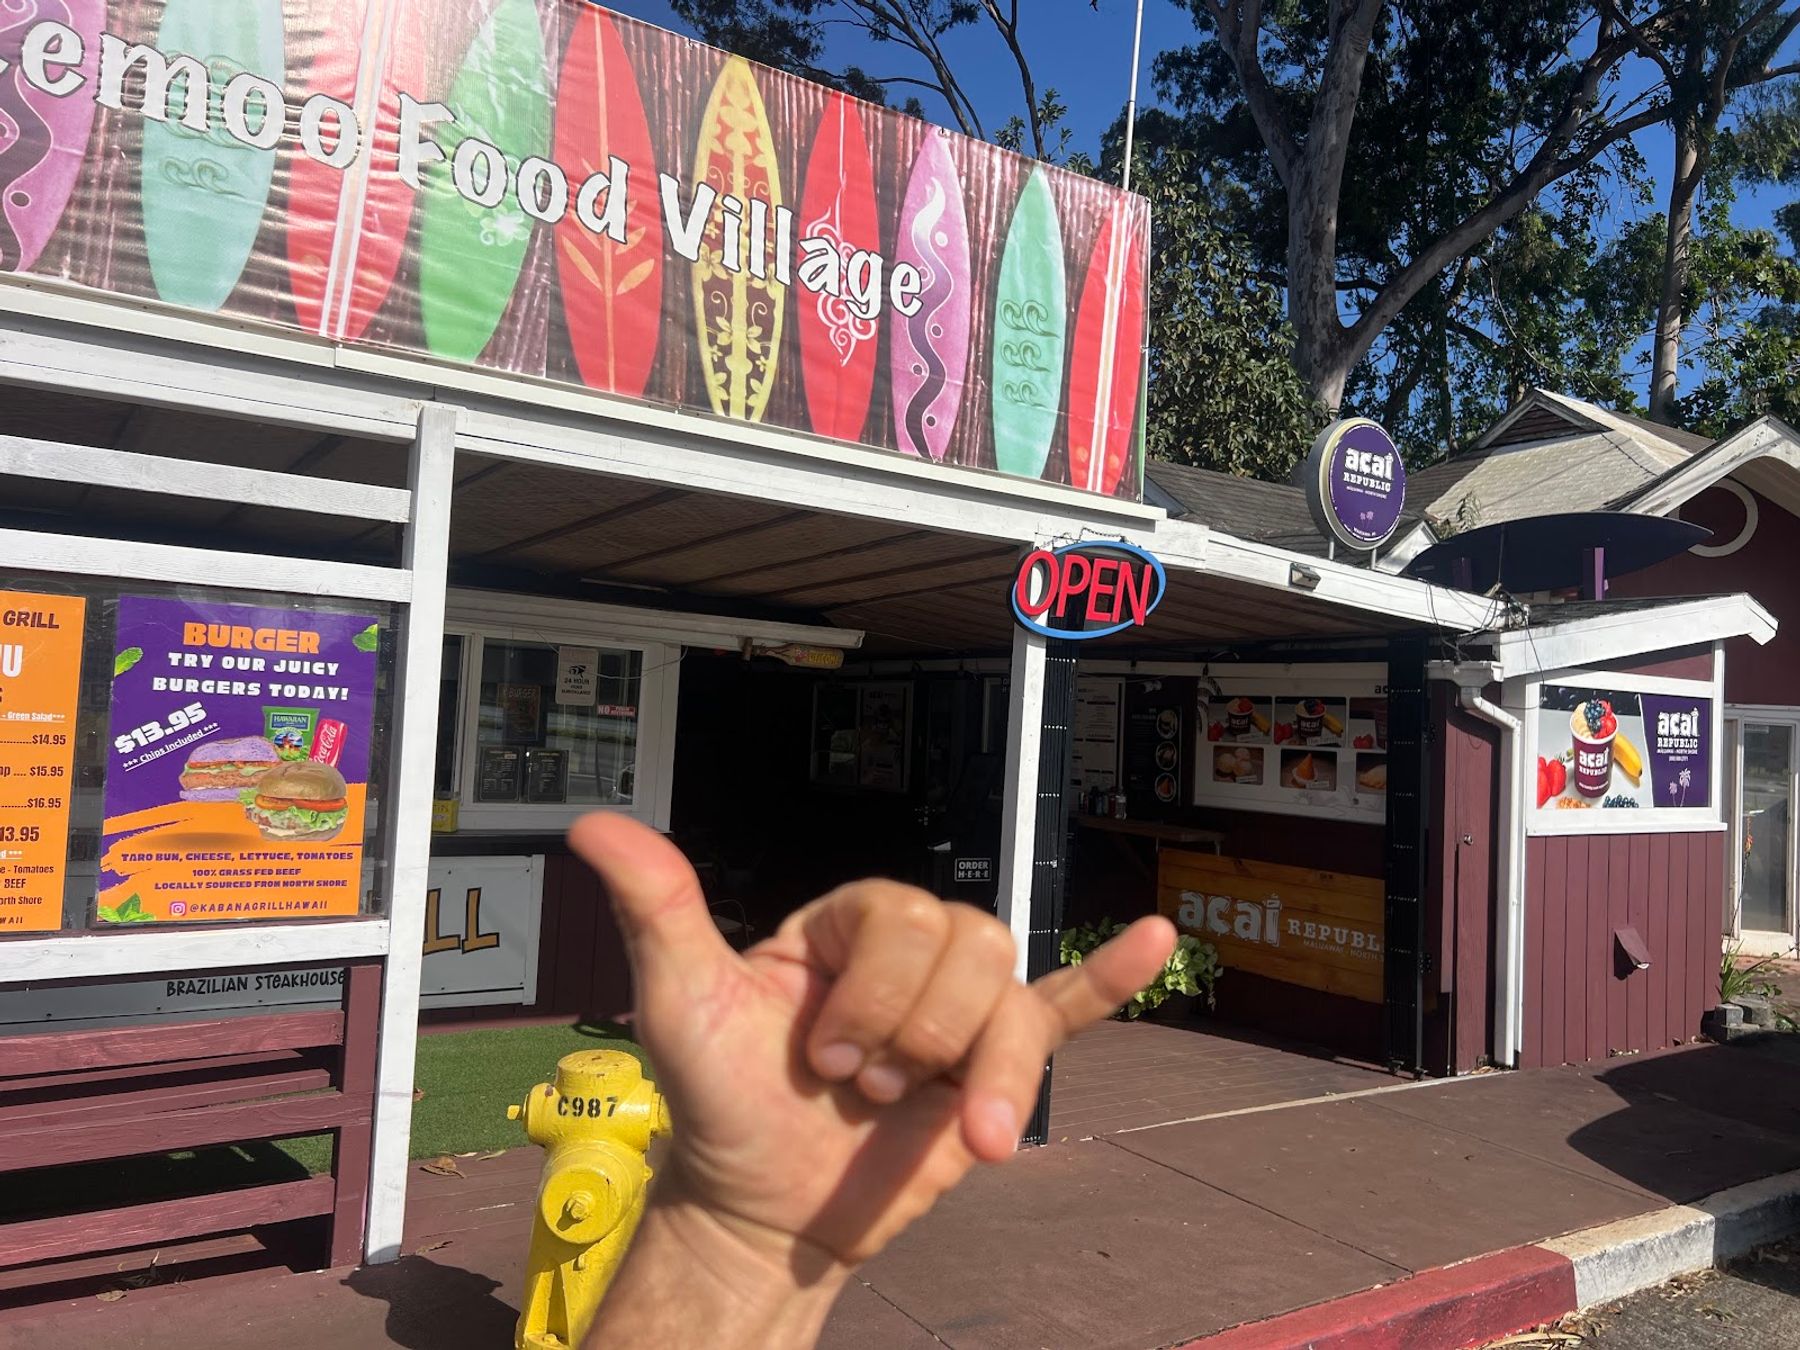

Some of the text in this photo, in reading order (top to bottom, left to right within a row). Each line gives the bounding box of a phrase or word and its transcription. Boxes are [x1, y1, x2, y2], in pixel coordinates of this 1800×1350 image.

[0, 20, 924, 321] emoo Food Village
[1343, 472, 1391, 493] REPUBLIC
[1016, 550, 1152, 626] OPEN
[3, 609, 60, 630] GRILL
[183, 622, 320, 654] BURGER
[168, 652, 340, 676] TRY OUR JUICY
[152, 677, 350, 701] BURGERS TODAY!
[7, 711, 30, 720] Green
[598, 705, 610, 715] NO
[114, 701, 208, 756] $13.95
[32, 734, 66, 746] $14.95
[1657, 737, 1699, 748] REPUBLIC
[139, 729, 204, 764] Chips Included
[29, 766, 64, 777] $15.95
[27, 797, 61, 809] $16.95
[121, 852, 353, 863] TARO BUN, CHEESE, LETTUCE, TOMATOES
[14, 865, 54, 874] Tomatoes
[958, 861, 989, 870] ORDER
[192, 868, 302, 877] 100% GRASS FED BEEF
[4, 878, 27, 889] BEEF
[154, 879, 348, 890] LOCALLY SOURCED FROM NORTH SHORE
[18, 896, 42, 905] Shore
[190, 901, 328, 913] @KABANAGRILLHAWAII
[1287, 918, 1382, 953] REPUBL
[166, 976, 248, 998] BRAZILIAN
[557, 1096, 618, 1118] C987
